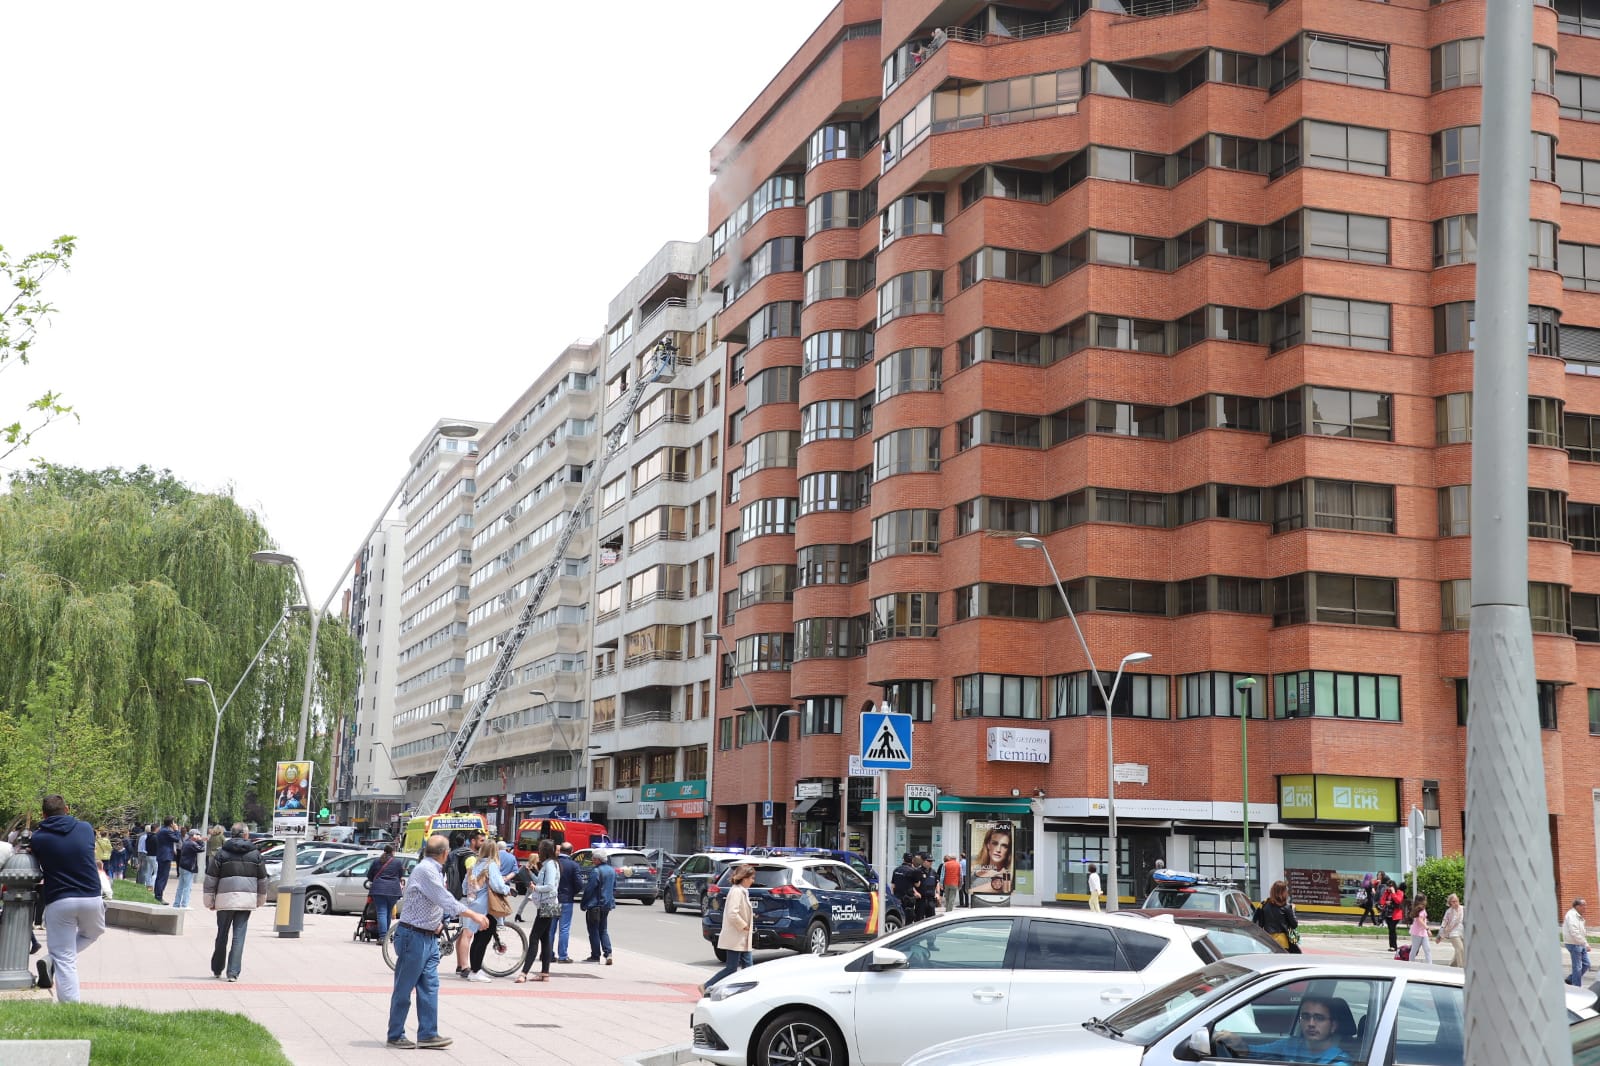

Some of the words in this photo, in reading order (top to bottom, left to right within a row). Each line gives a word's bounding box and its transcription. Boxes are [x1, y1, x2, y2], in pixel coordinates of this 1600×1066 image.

[1000, 747, 1047, 761] temiño
[765, 803, 770, 816] P
[832, 904, 856, 913] POLICÍA
[832, 913, 864, 921] NACIONAL
